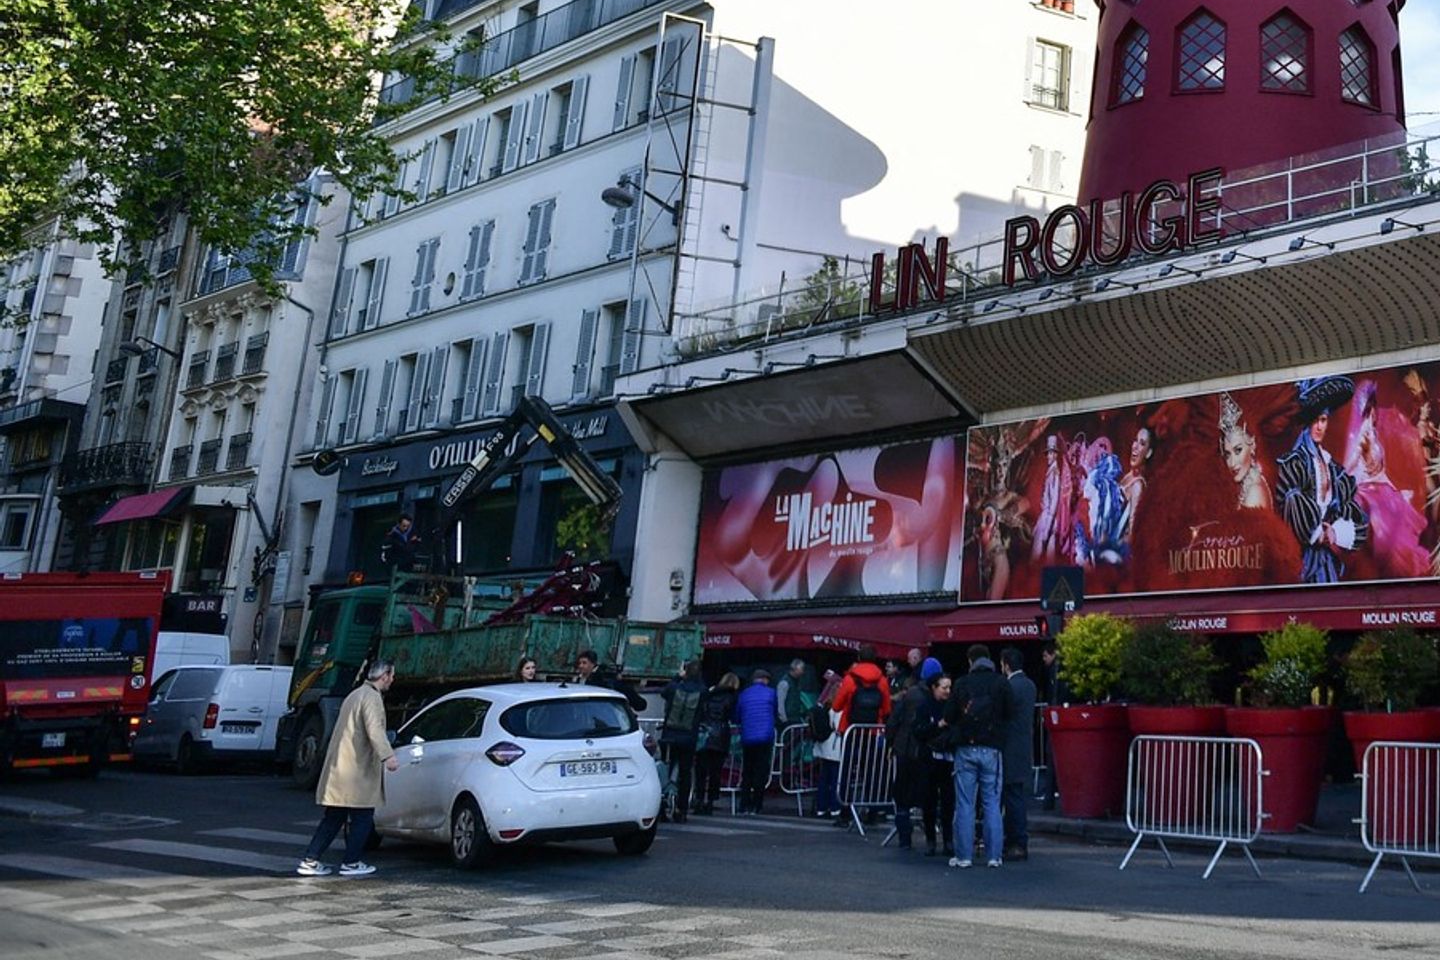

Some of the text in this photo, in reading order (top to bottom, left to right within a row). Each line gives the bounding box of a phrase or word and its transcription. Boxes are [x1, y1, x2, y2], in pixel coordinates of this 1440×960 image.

[1002, 167, 1223, 287] ROUGE
[443, 467, 477, 506] FASSI
[775, 495, 789, 515] LA
[1168, 543, 1263, 575] MOULIN ROUGE
[188, 600, 216, 611] BAR
[1199, 617, 1228, 629] ROUGE
[1362, 611, 1436, 625] MOULIN ROUGE
[1000, 624, 1027, 636] MOULIN
